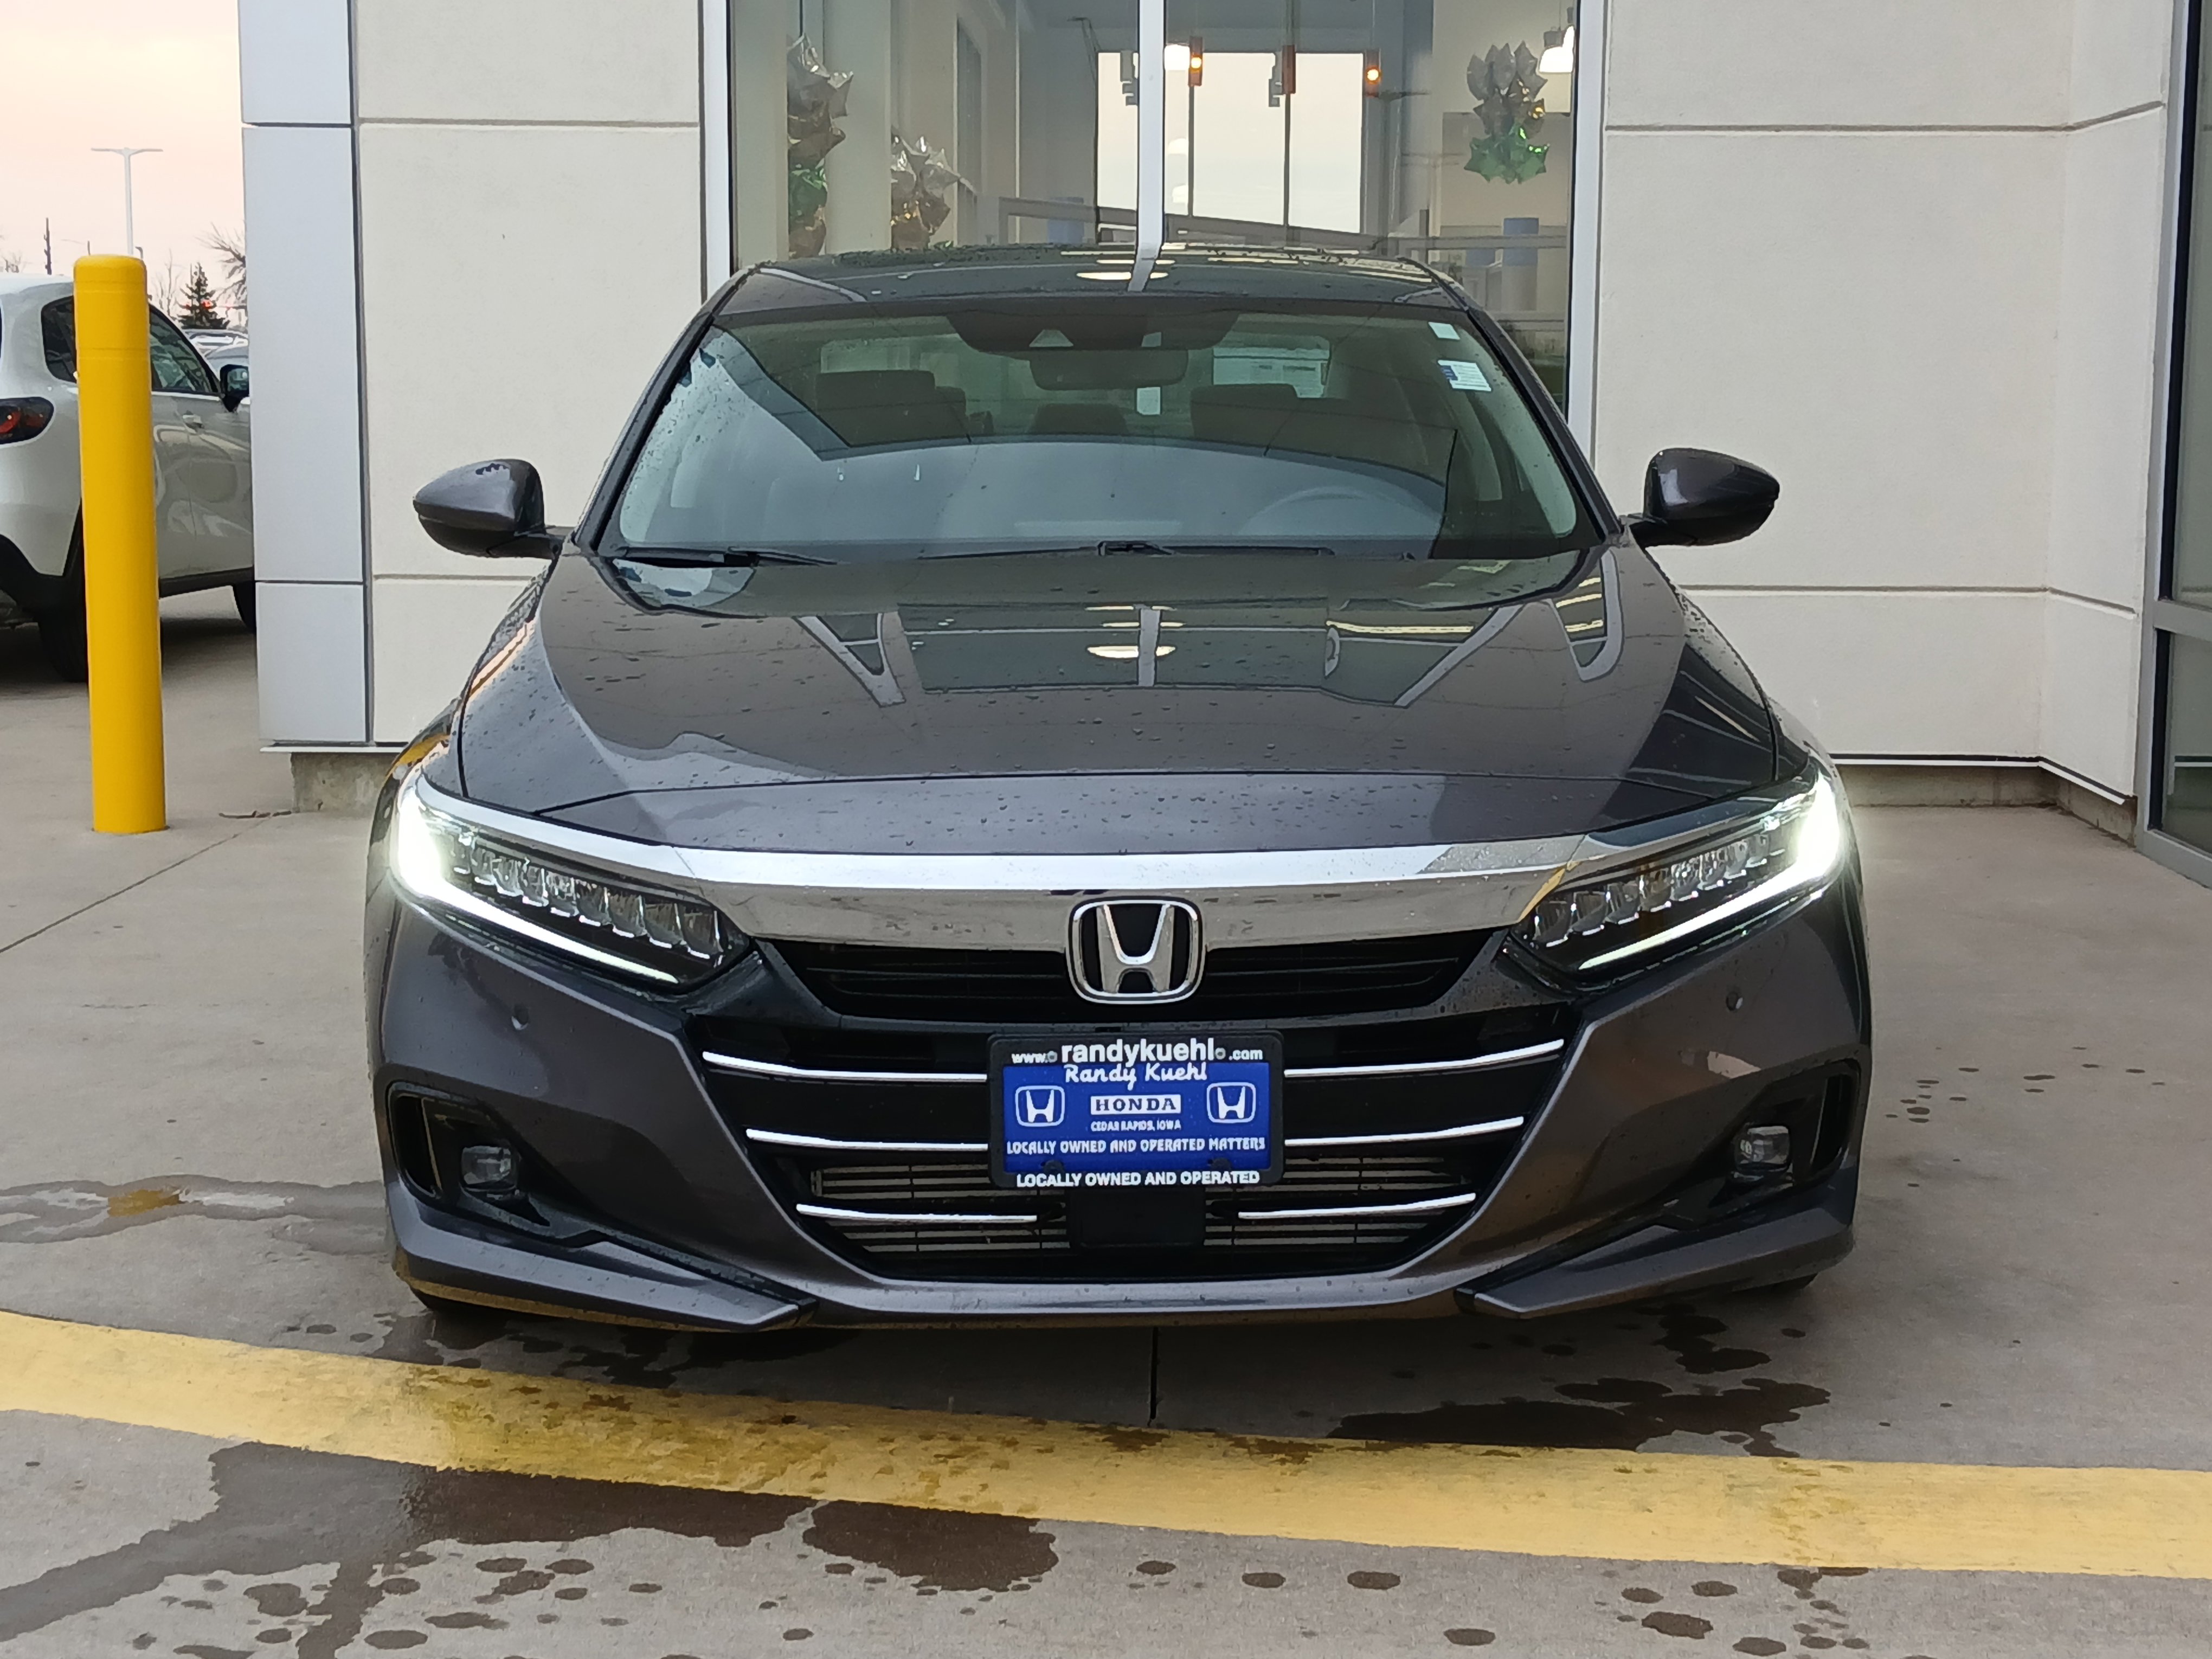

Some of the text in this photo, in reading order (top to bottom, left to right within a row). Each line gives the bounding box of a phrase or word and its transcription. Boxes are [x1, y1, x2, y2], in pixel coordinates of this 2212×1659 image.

[1063, 1062, 1207, 1091] Randy Kuehl
[1095, 1098, 1176, 1111] HONDA
[1156, 1118, 1181, 1131] IOWA
[1007, 1137, 1265, 1155] LOCALLY OWNED AND OPERATED MATTERS
[1017, 1170, 1260, 1187] LOCALLY OWNED AND OPERATED
